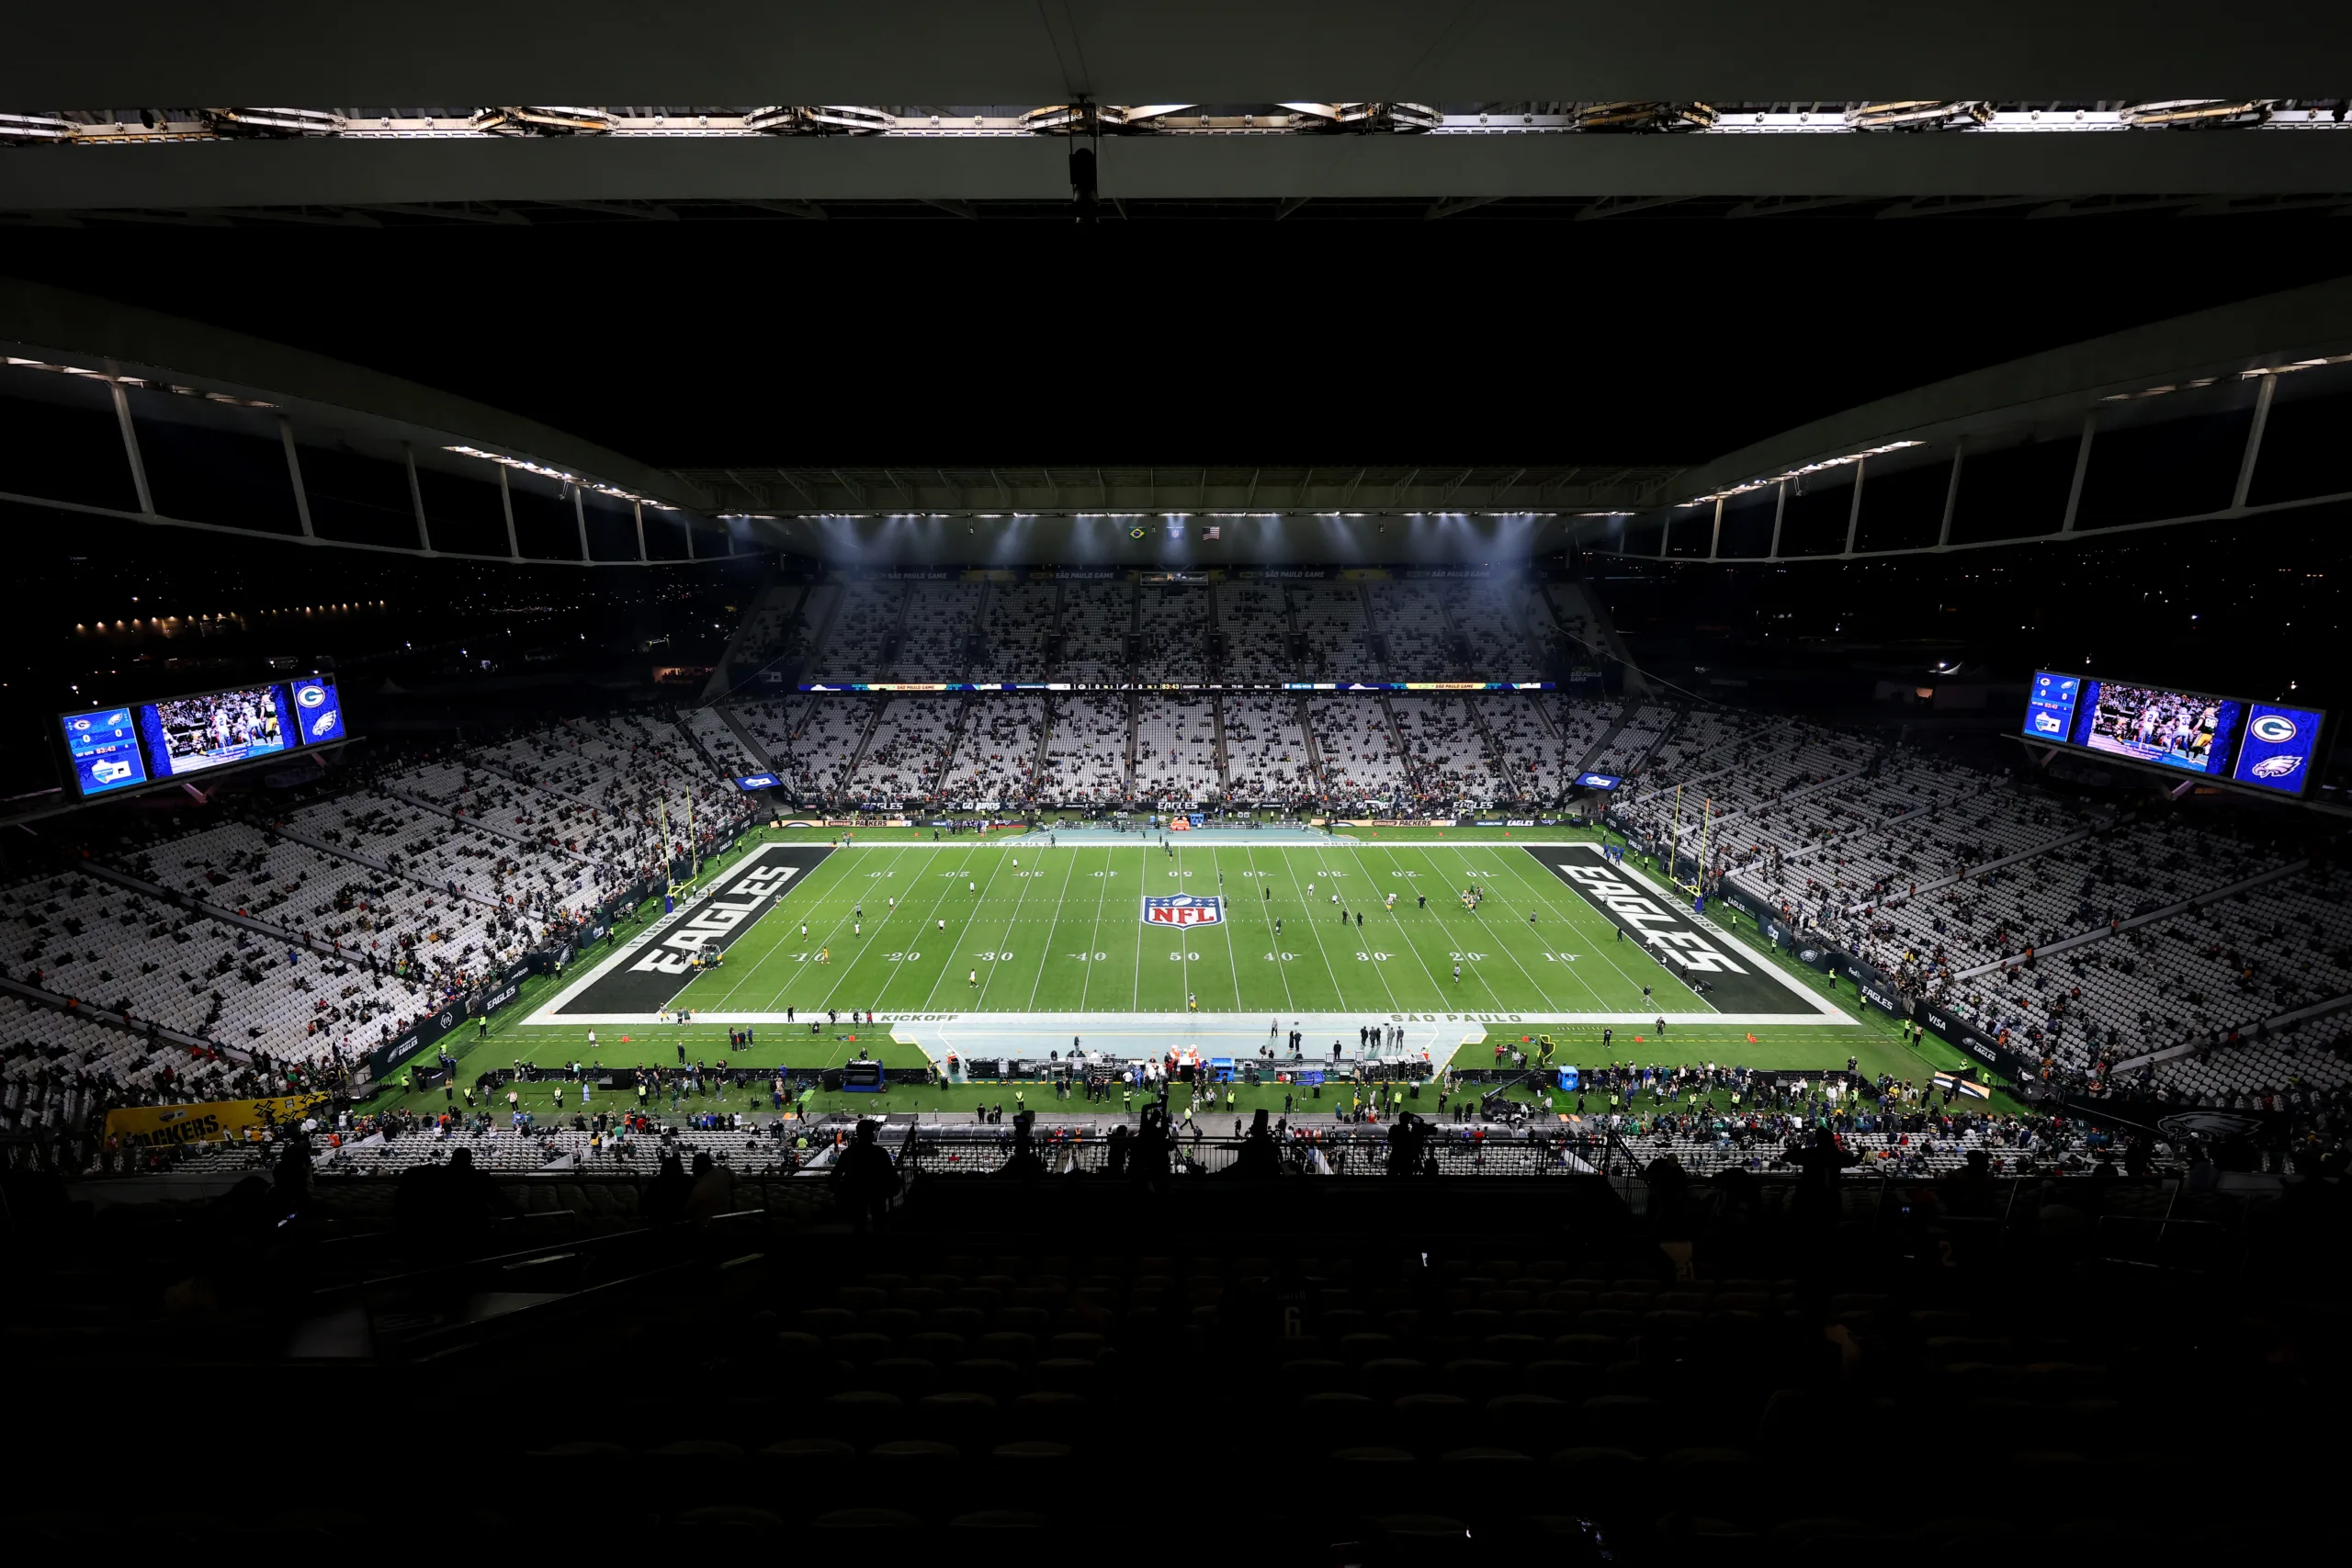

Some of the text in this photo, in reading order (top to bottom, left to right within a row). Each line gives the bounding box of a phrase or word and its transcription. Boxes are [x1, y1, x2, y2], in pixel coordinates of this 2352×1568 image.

[83, 728, 122, 743] 0 0
[1158, 802, 1199, 810] EAGLES
[1727, 896, 1745, 912] EAGLES
[626, 865, 800, 975] EAGLES
[1152, 908, 1215, 924] NFL
[1558, 864, 1751, 975] EAGLES
[887, 952, 921, 962] 20
[980, 952, 1014, 962] 30
[1076, 952, 1107, 962] 40
[1170, 952, 1200, 962] 50
[1263, 952, 1295, 962] 40
[1355, 952, 1388, 962] 30
[1449, 952, 1482, 962] 20
[1541, 952, 1575, 962] 10
[487, 985, 515, 1010] EAGLES
[1861, 985, 1894, 1011] EAGLES
[1928, 1011, 1946, 1031] VISA
[399, 1038, 418, 1056] EAGLES
[1973, 1044, 1996, 1062] EAGLES
[138, 1114, 220, 1146] ACKERS
